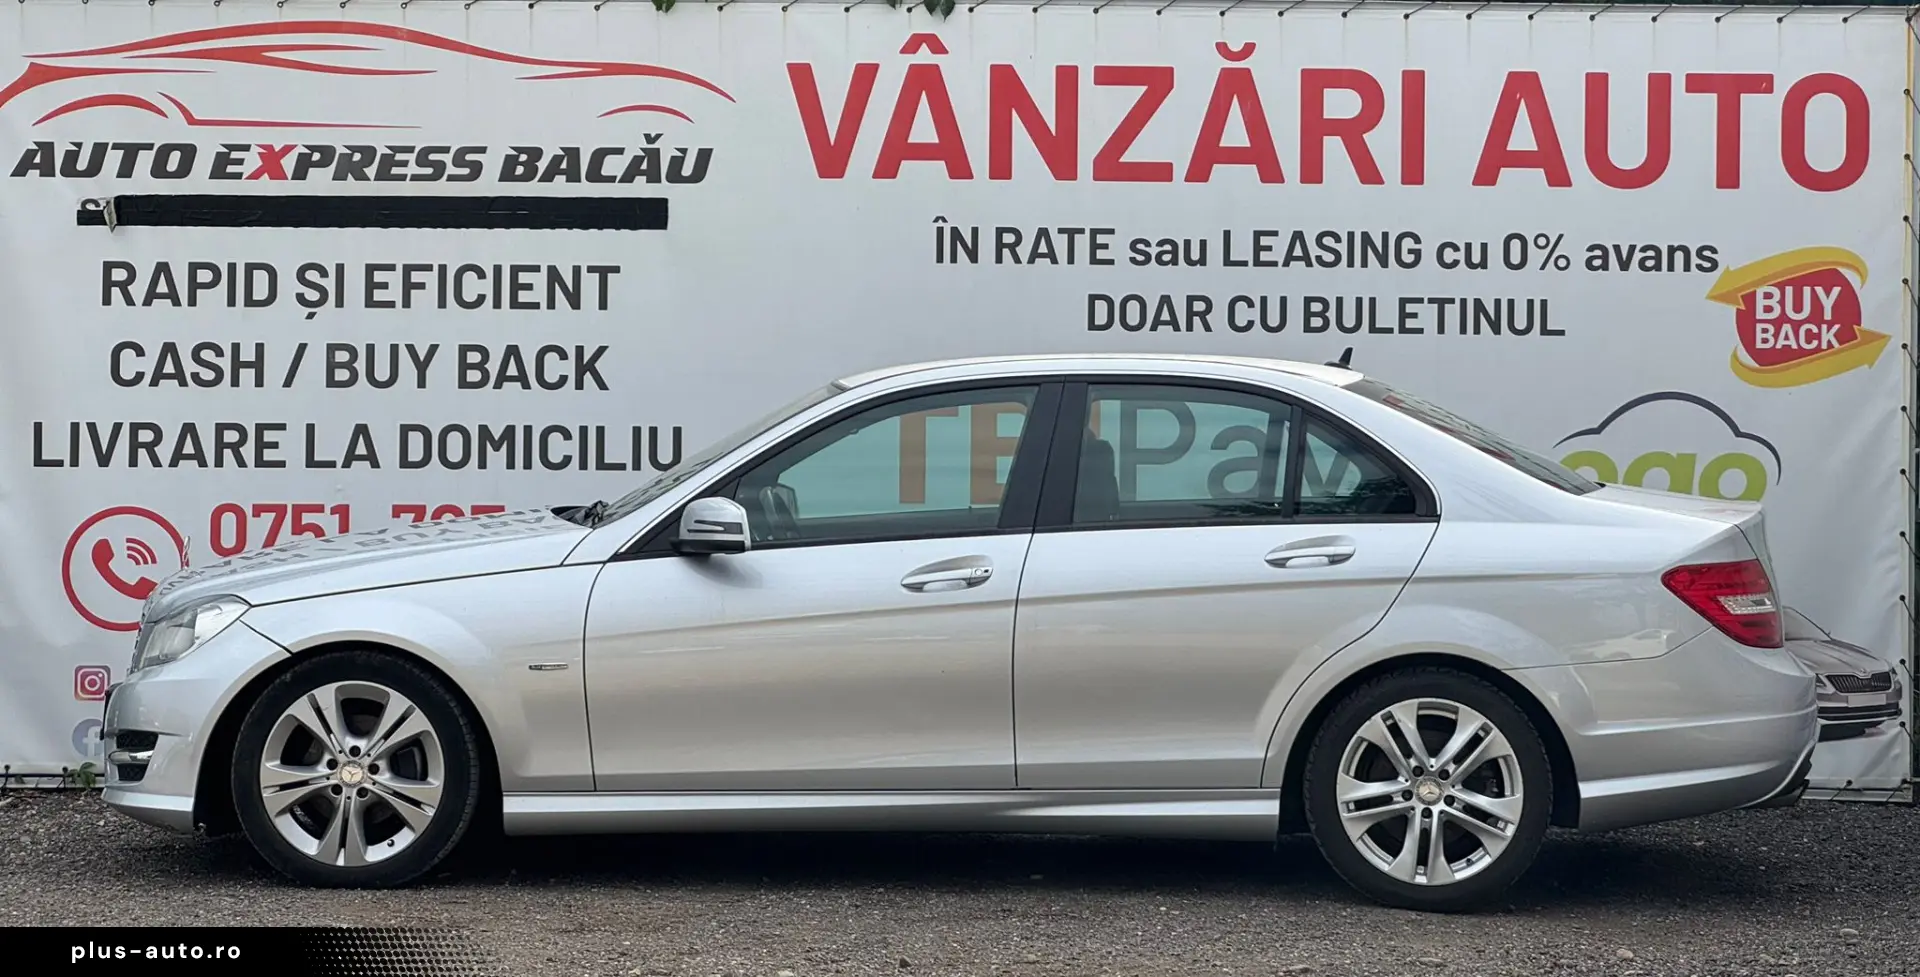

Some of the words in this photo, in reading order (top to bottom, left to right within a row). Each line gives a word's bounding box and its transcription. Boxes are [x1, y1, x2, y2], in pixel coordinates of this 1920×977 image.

[787, 33, 1425, 185] VÂNZĂRI
[1472, 70, 1870, 192] AUTO
[10, 140, 197, 180] AUTO
[208, 143, 488, 183] EXPRESS
[498, 133, 713, 185] BACĂU
[932, 216, 979, 264] ÎN
[995, 226, 1115, 266] RATE
[1128, 237, 1208, 267] sau
[1222, 229, 1422, 270] LEASING
[1435, 241, 1489, 270] cu
[1503, 232, 1570, 272] 0%
[1585, 243, 1719, 274] avans
[102, 260, 278, 308] RAPID
[365, 263, 621, 311] EFICIENT
[1755, 285, 1842, 321] BUY
[1087, 293, 1214, 333] DOAR
[1228, 294, 1288, 333] CU
[1302, 295, 1566, 337] BULETINUL
[1755, 322, 1841, 350] BACK
[110, 340, 265, 388] CASH
[281, 342, 309, 389] /
[325, 342, 440, 390] BUY
[458, 343, 610, 391] BACK
[33, 421, 287, 469] LIVRARE
[305, 423, 381, 469] LA
[398, 423, 682, 472] DOMICILIU
